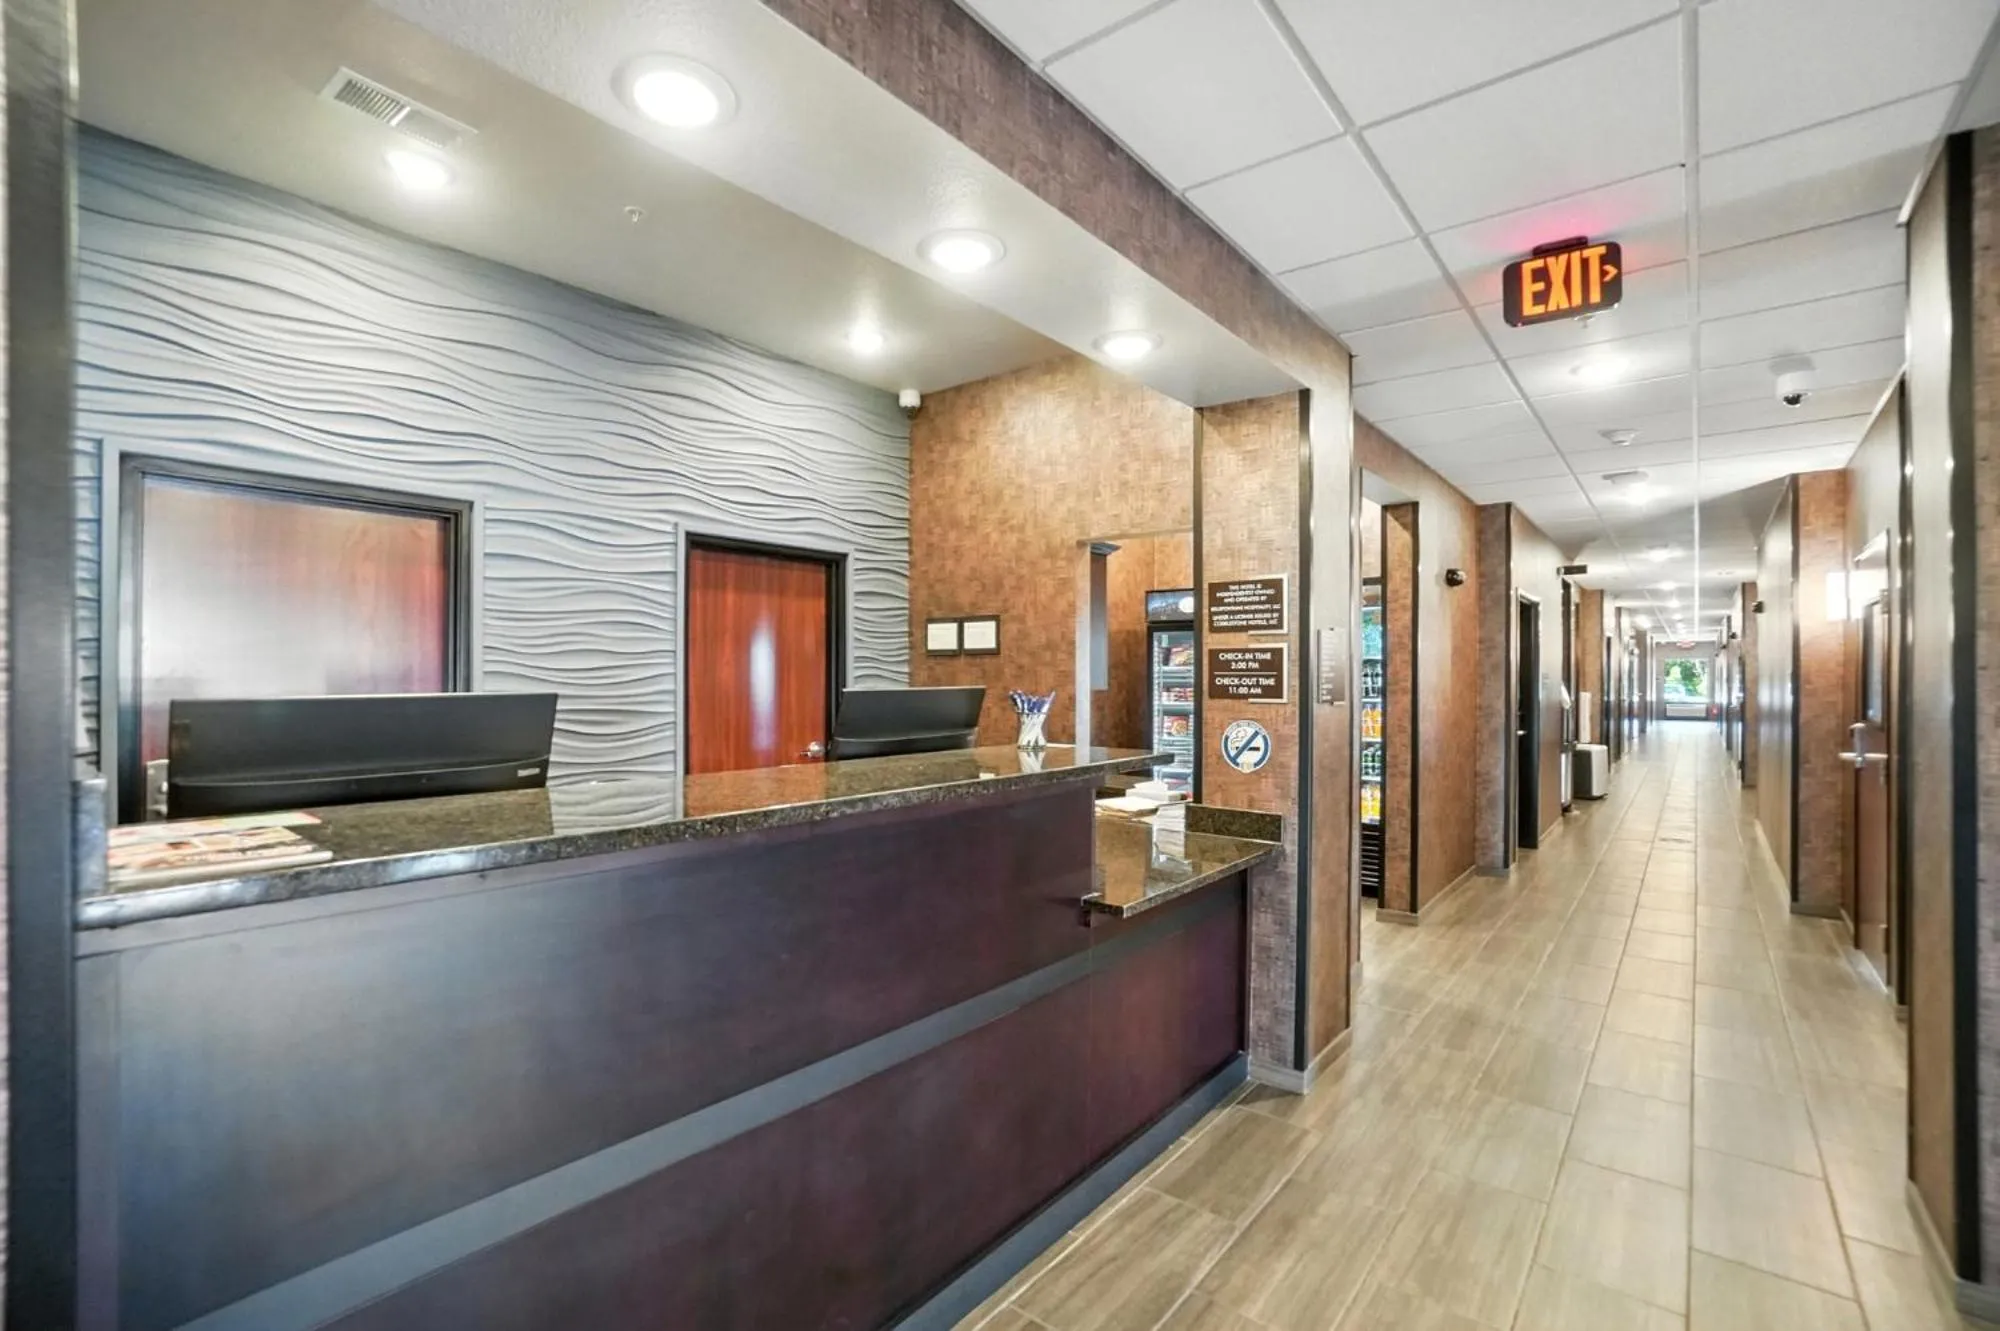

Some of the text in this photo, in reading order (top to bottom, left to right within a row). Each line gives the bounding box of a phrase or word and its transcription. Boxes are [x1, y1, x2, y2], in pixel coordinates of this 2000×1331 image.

[1521, 245, 1607, 316] EXIT
[1219, 652, 1272, 660] CHECK-IN TIME
